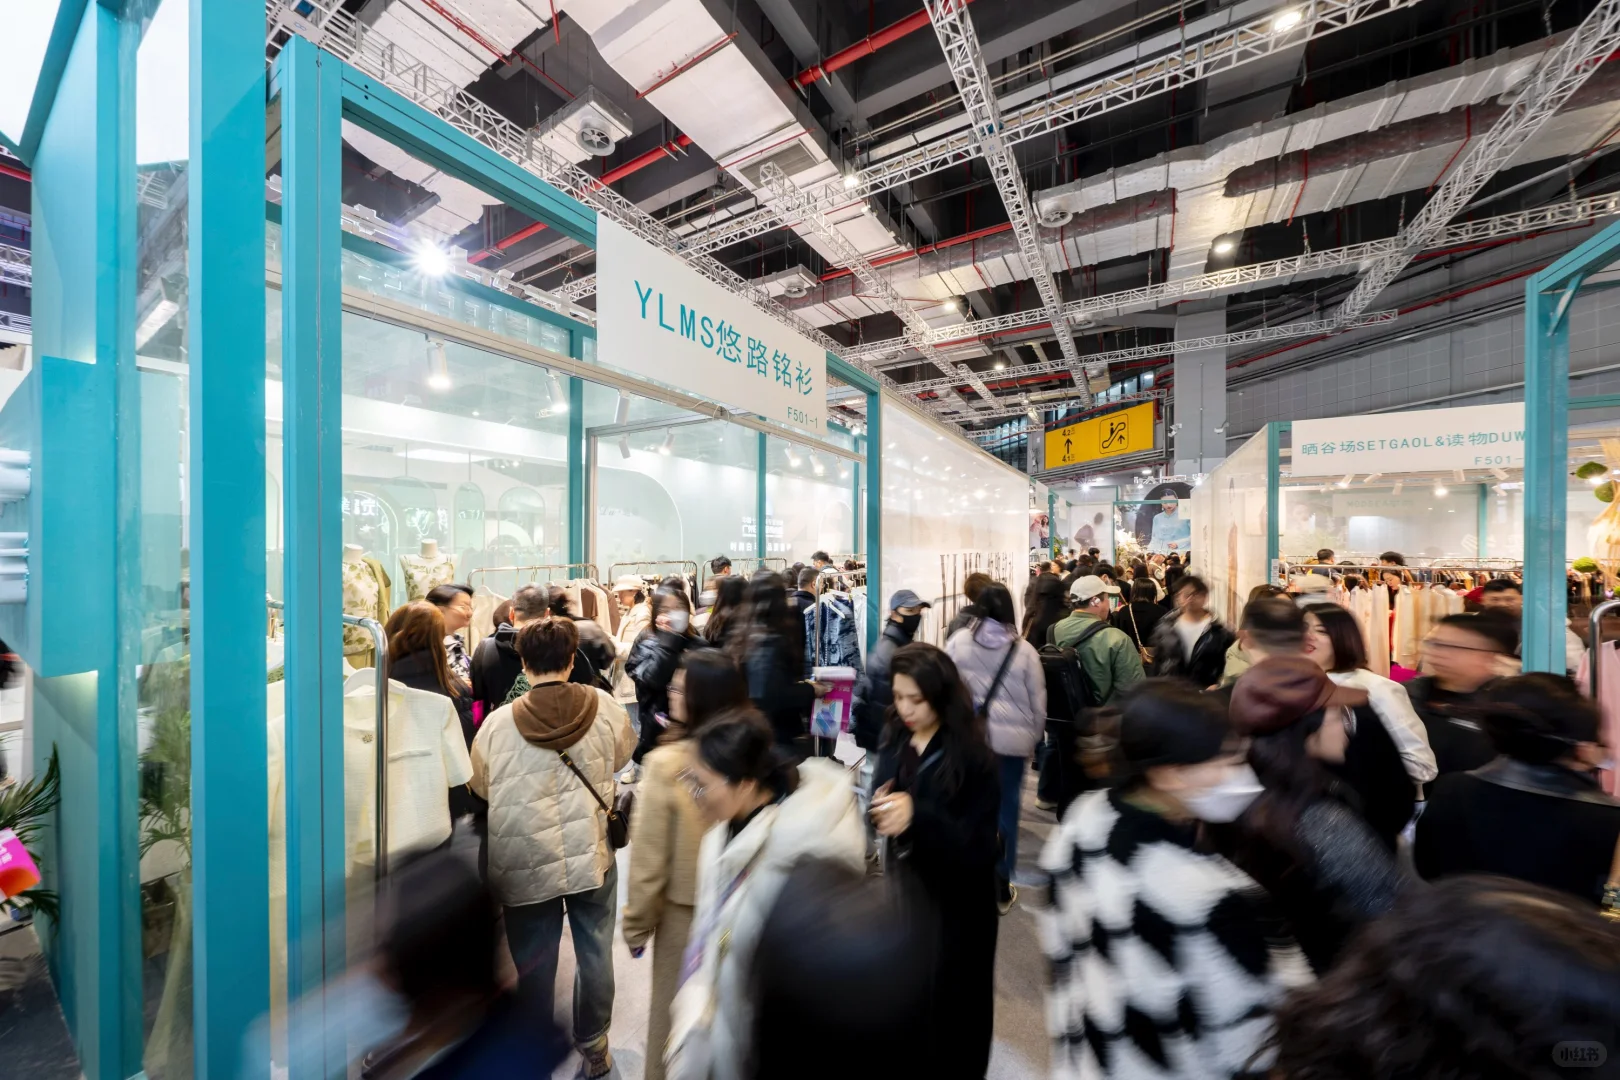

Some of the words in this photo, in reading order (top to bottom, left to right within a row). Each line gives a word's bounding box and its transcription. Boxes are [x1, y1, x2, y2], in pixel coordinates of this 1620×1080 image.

[633, 279, 814, 396] YLMS悠路铭衫
[787, 406, 819, 429] F501-1
